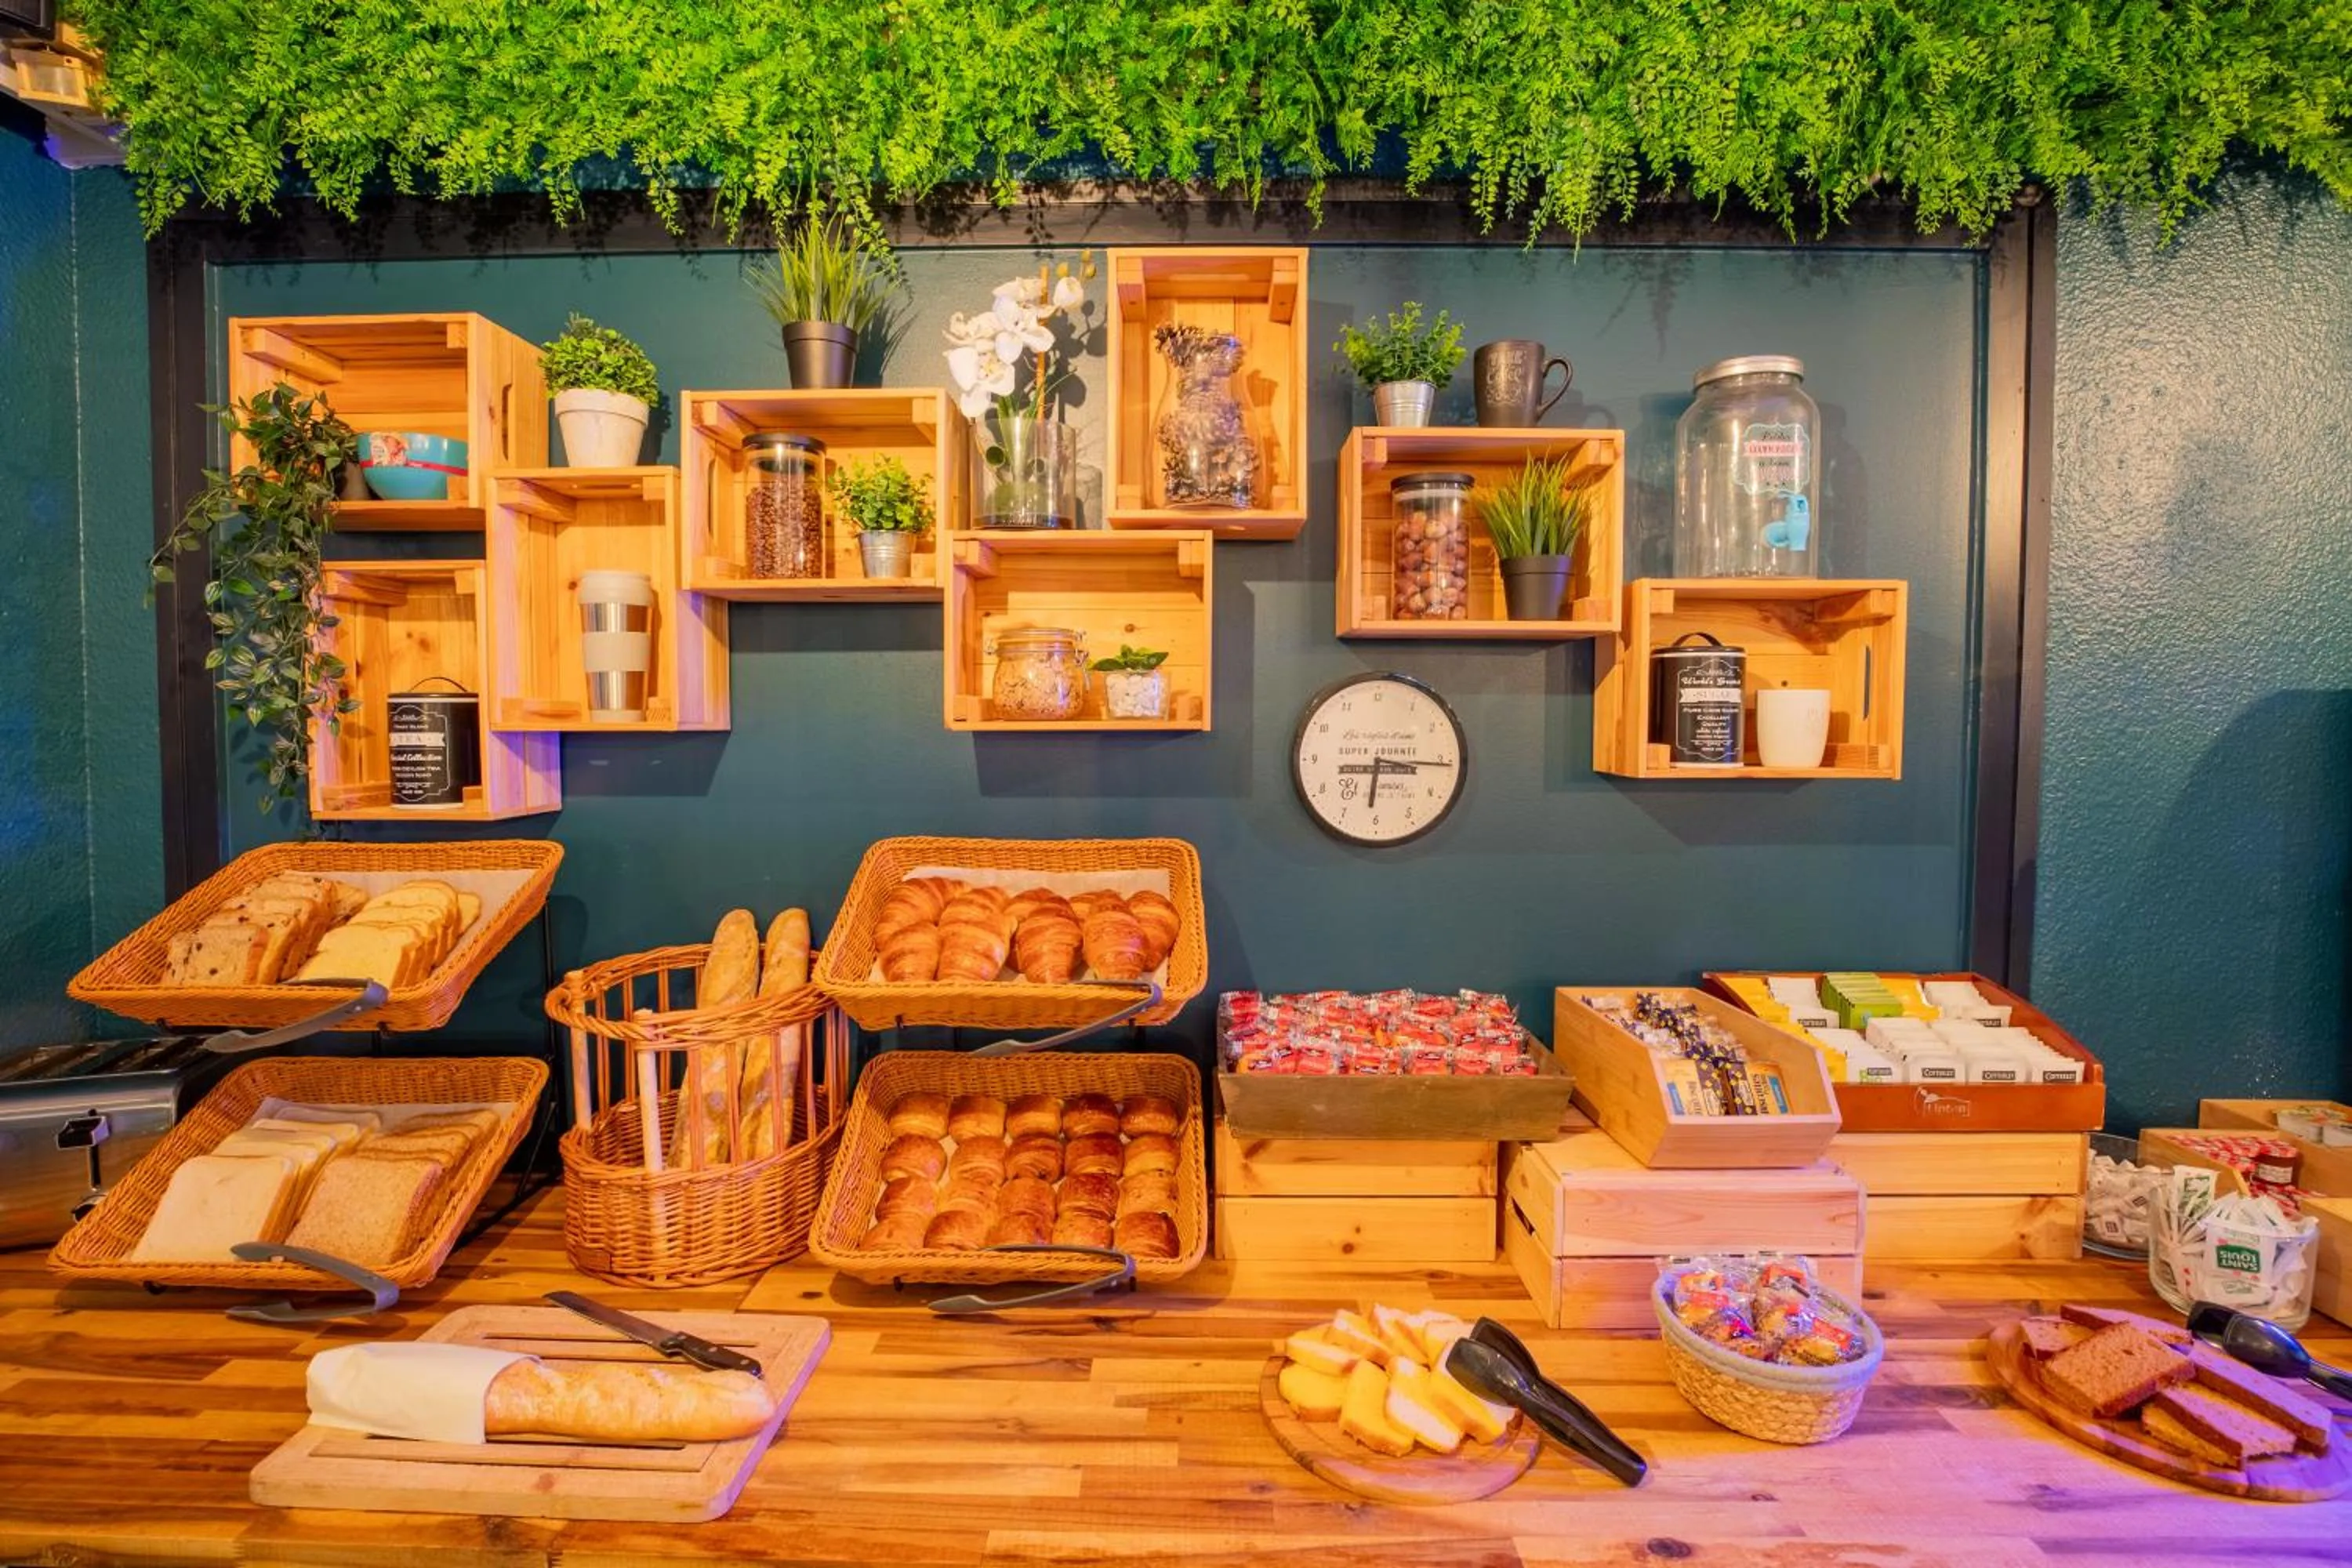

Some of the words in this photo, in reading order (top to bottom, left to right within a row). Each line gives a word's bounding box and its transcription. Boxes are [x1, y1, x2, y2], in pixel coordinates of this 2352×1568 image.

[1311, 754, 1318, 764] 9
[1372, 815, 1379, 826] 6
[2219, 1250, 2257, 1264] LOUIS
[2219, 1257, 2259, 1271] SAINT
